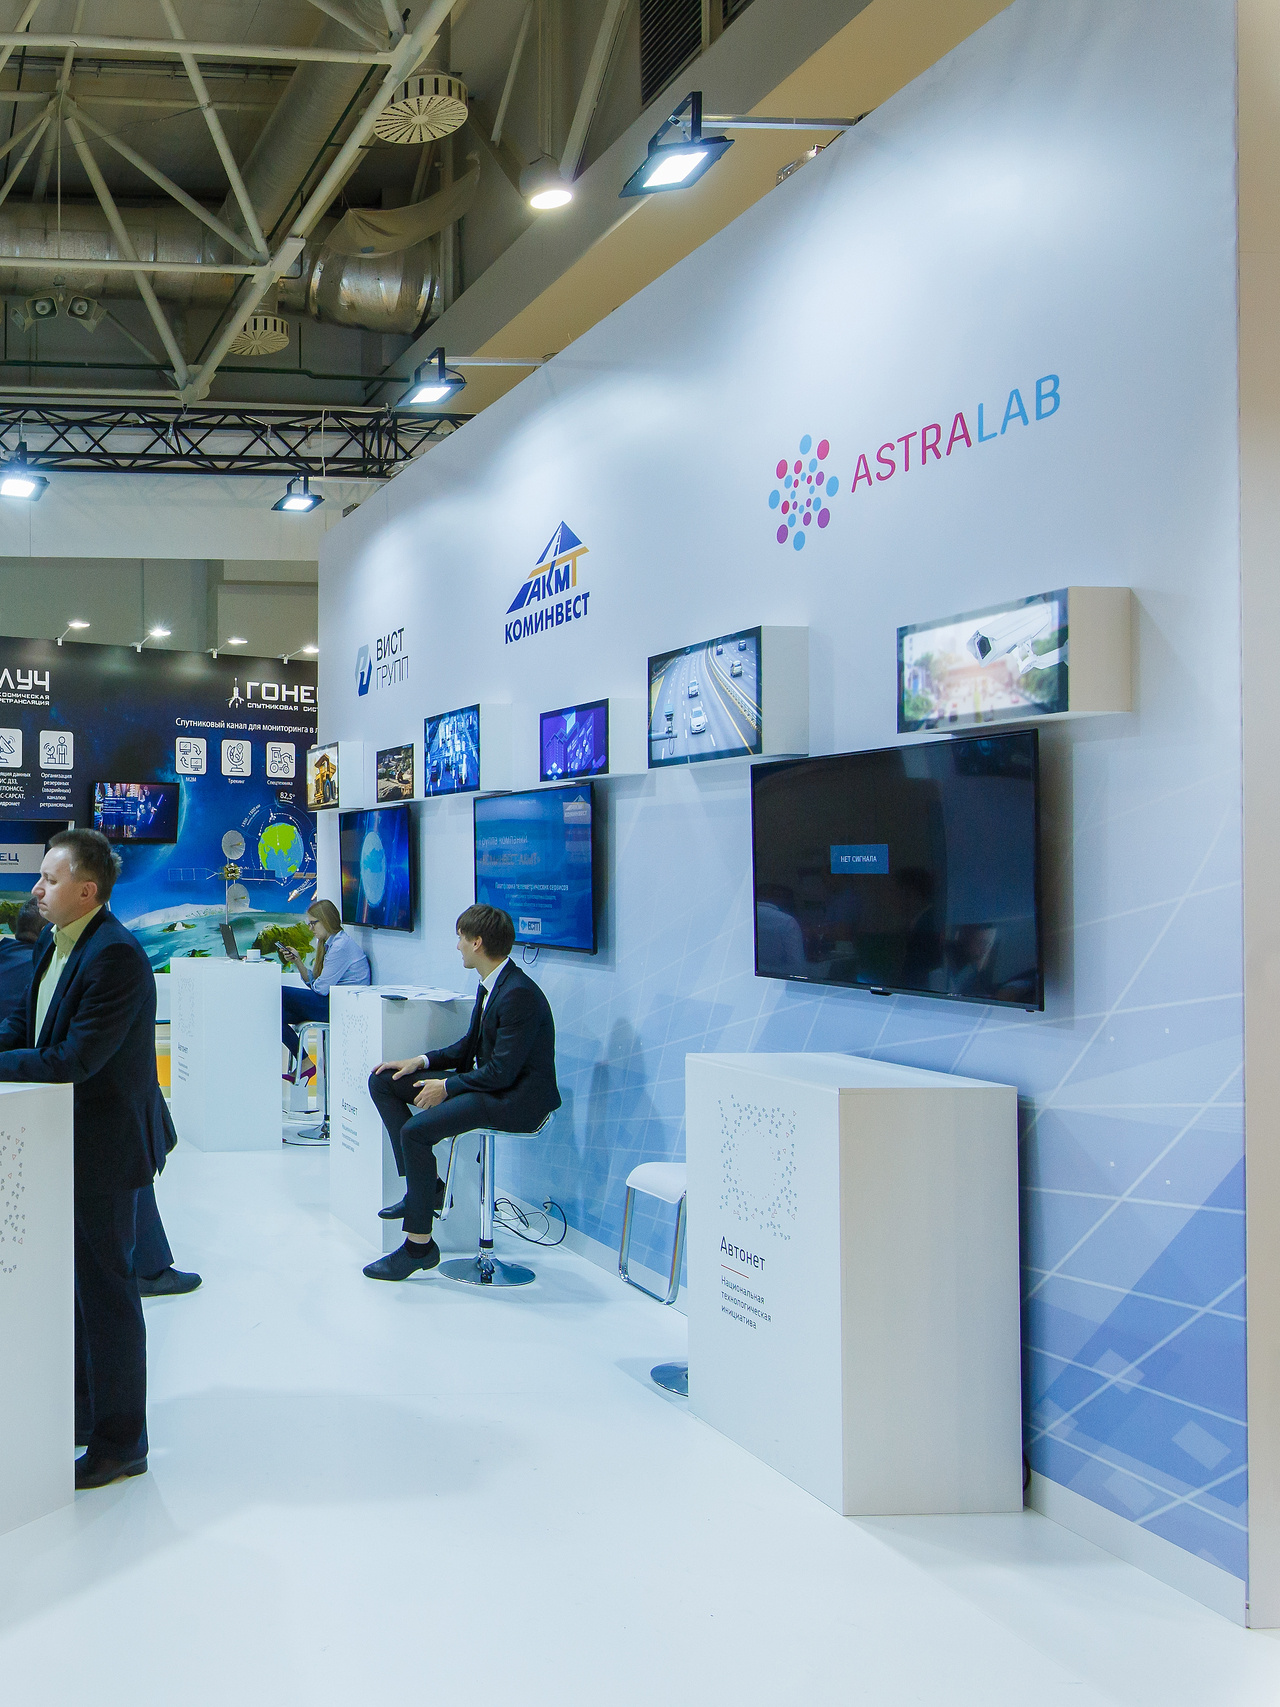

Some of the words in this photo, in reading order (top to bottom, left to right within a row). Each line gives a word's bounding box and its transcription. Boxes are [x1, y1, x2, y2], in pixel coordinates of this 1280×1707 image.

[851, 373, 1062, 494] ASTRALAB
[504, 591, 590, 645] КОМИНВЕСТ
[376, 626, 405, 662] ВИСТ
[376, 655, 409, 691] ГРУПП
[246, 681, 318, 703] ГОНЕ
[247, 702, 299, 712] СПУТНИКОВАЯ
[175, 717, 226, 729] Спутниковый
[226, 722, 247, 731] канал
[248, 724, 262, 732] для
[262, 725, 308, 735] мониторинга
[840, 855, 851, 863] НЕТ
[851, 855, 878, 863] СИГНАЛА
[720, 1235, 766, 1271] Автонет
[721, 1275, 765, 1305] Национальная
[721, 1290, 772, 1323] технологическая
[721, 1305, 757, 1330] инициатива
